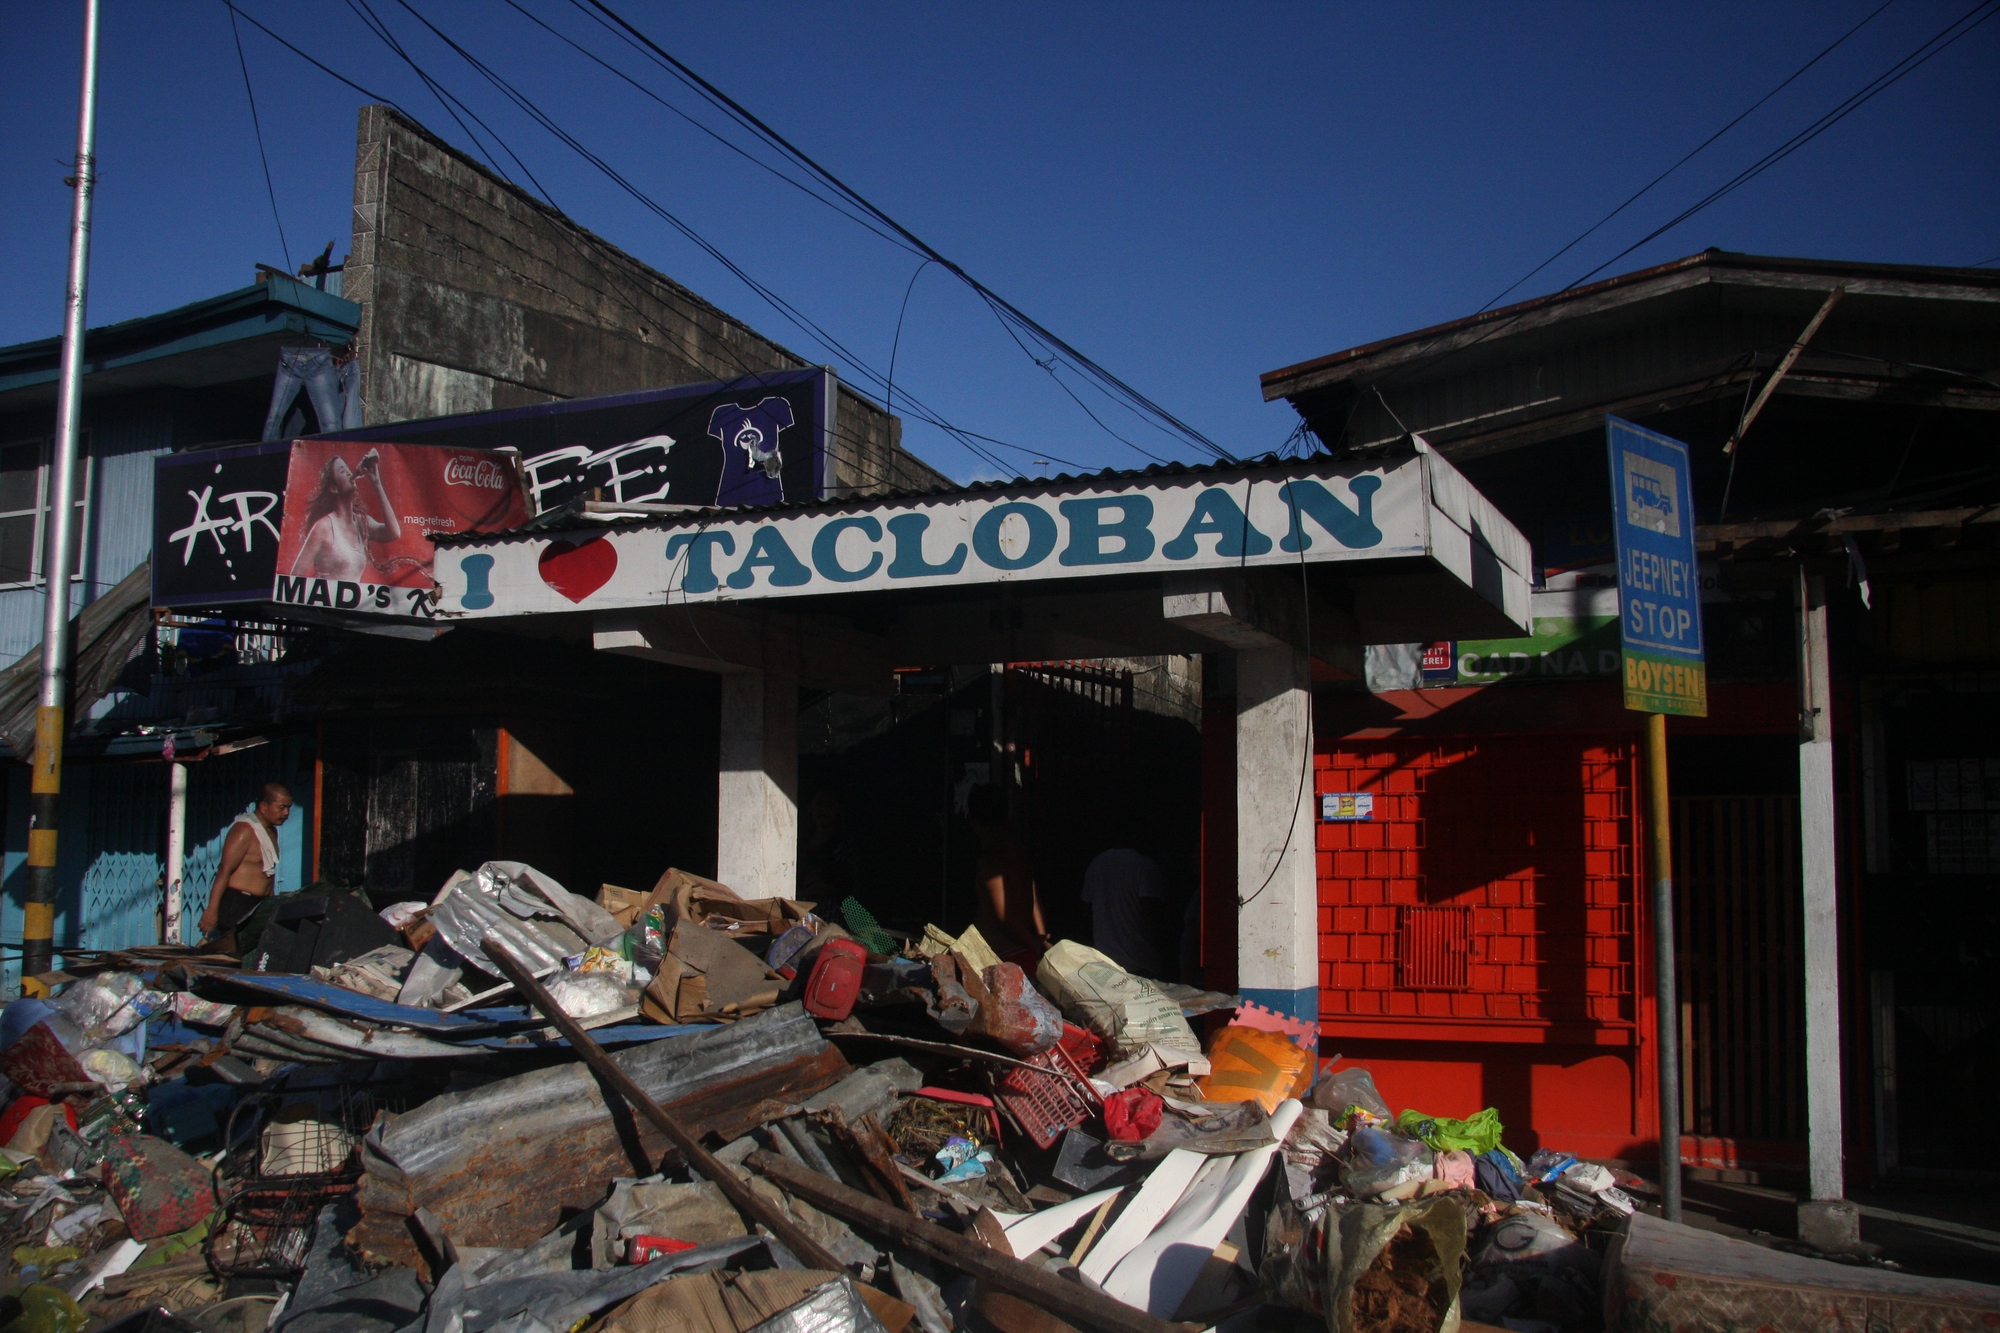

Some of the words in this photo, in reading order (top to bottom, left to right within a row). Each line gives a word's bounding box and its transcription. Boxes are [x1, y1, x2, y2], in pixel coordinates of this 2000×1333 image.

[444, 457, 504, 490] Coca-Cola
[403, 515, 456, 528] mag-refresh
[461, 553, 495, 610] I
[665, 475, 1383, 594] TACLOBAN
[1625, 548, 1690, 599] JEEPNEY
[1631, 599, 1691, 641] STOP
[1435, 647, 1445, 656] IT
[1541, 651, 1589, 676] NA
[1626, 657, 1699, 697] BOYSEN
